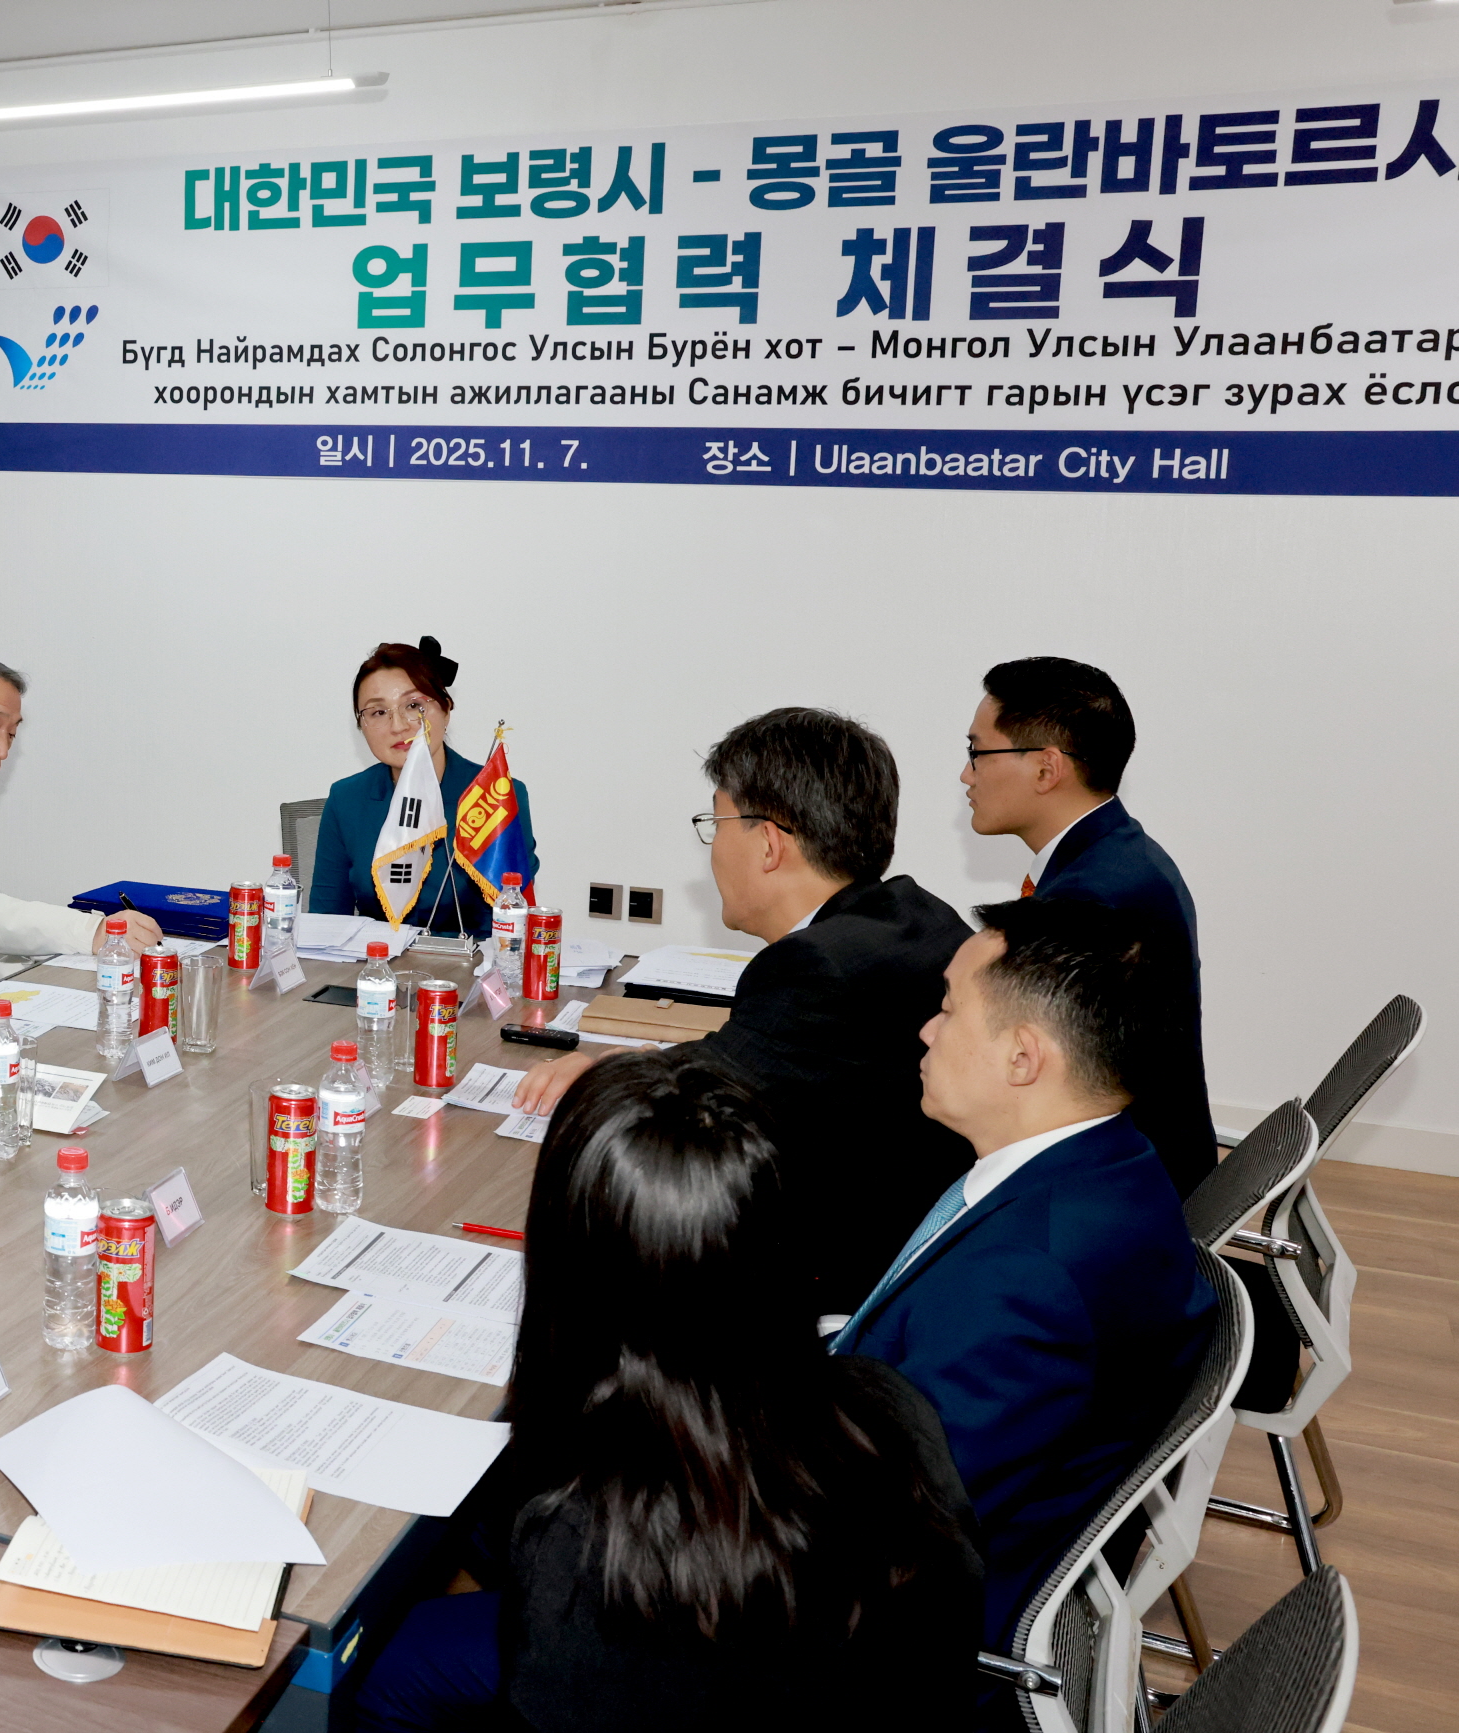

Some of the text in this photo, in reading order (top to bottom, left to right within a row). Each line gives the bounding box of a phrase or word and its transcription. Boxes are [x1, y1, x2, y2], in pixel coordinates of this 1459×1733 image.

[185, 155, 436, 231] 대한민국
[456, 142, 665, 219] 보령시
[747, 130, 902, 210] 몽골
[353, 217, 1204, 329] 업무협력 체결식
[123, 340, 185, 370] Бүгд
[197, 336, 359, 369] Найрамдах
[373, 337, 516, 362] Солонгос
[529, 335, 633, 361] Улсын
[648, 331, 750, 367] Бурён
[765, 339, 822, 359] хот
[872, 330, 1009, 358] Монгол
[1027, 328, 1155, 357] Улсын
[154, 386, 314, 410] хоорондын
[326, 386, 437, 404] хамтын
[451, 385, 674, 404] ажиллагааны
[689, 378, 827, 405] Санамж
[842, 377, 972, 405] бичигт
[988, 385, 1106, 414] гарын
[1123, 384, 1210, 414] үсэг
[1225, 383, 1347, 414] зурах
[317, 435, 372, 466] 일시
[561, 440, 587, 469] 7.
[703, 441, 771, 474] 장소
[815, 445, 1042, 476] Ulaanbaatar
[1059, 447, 1135, 483] City
[1153, 448, 1228, 479] Hall
